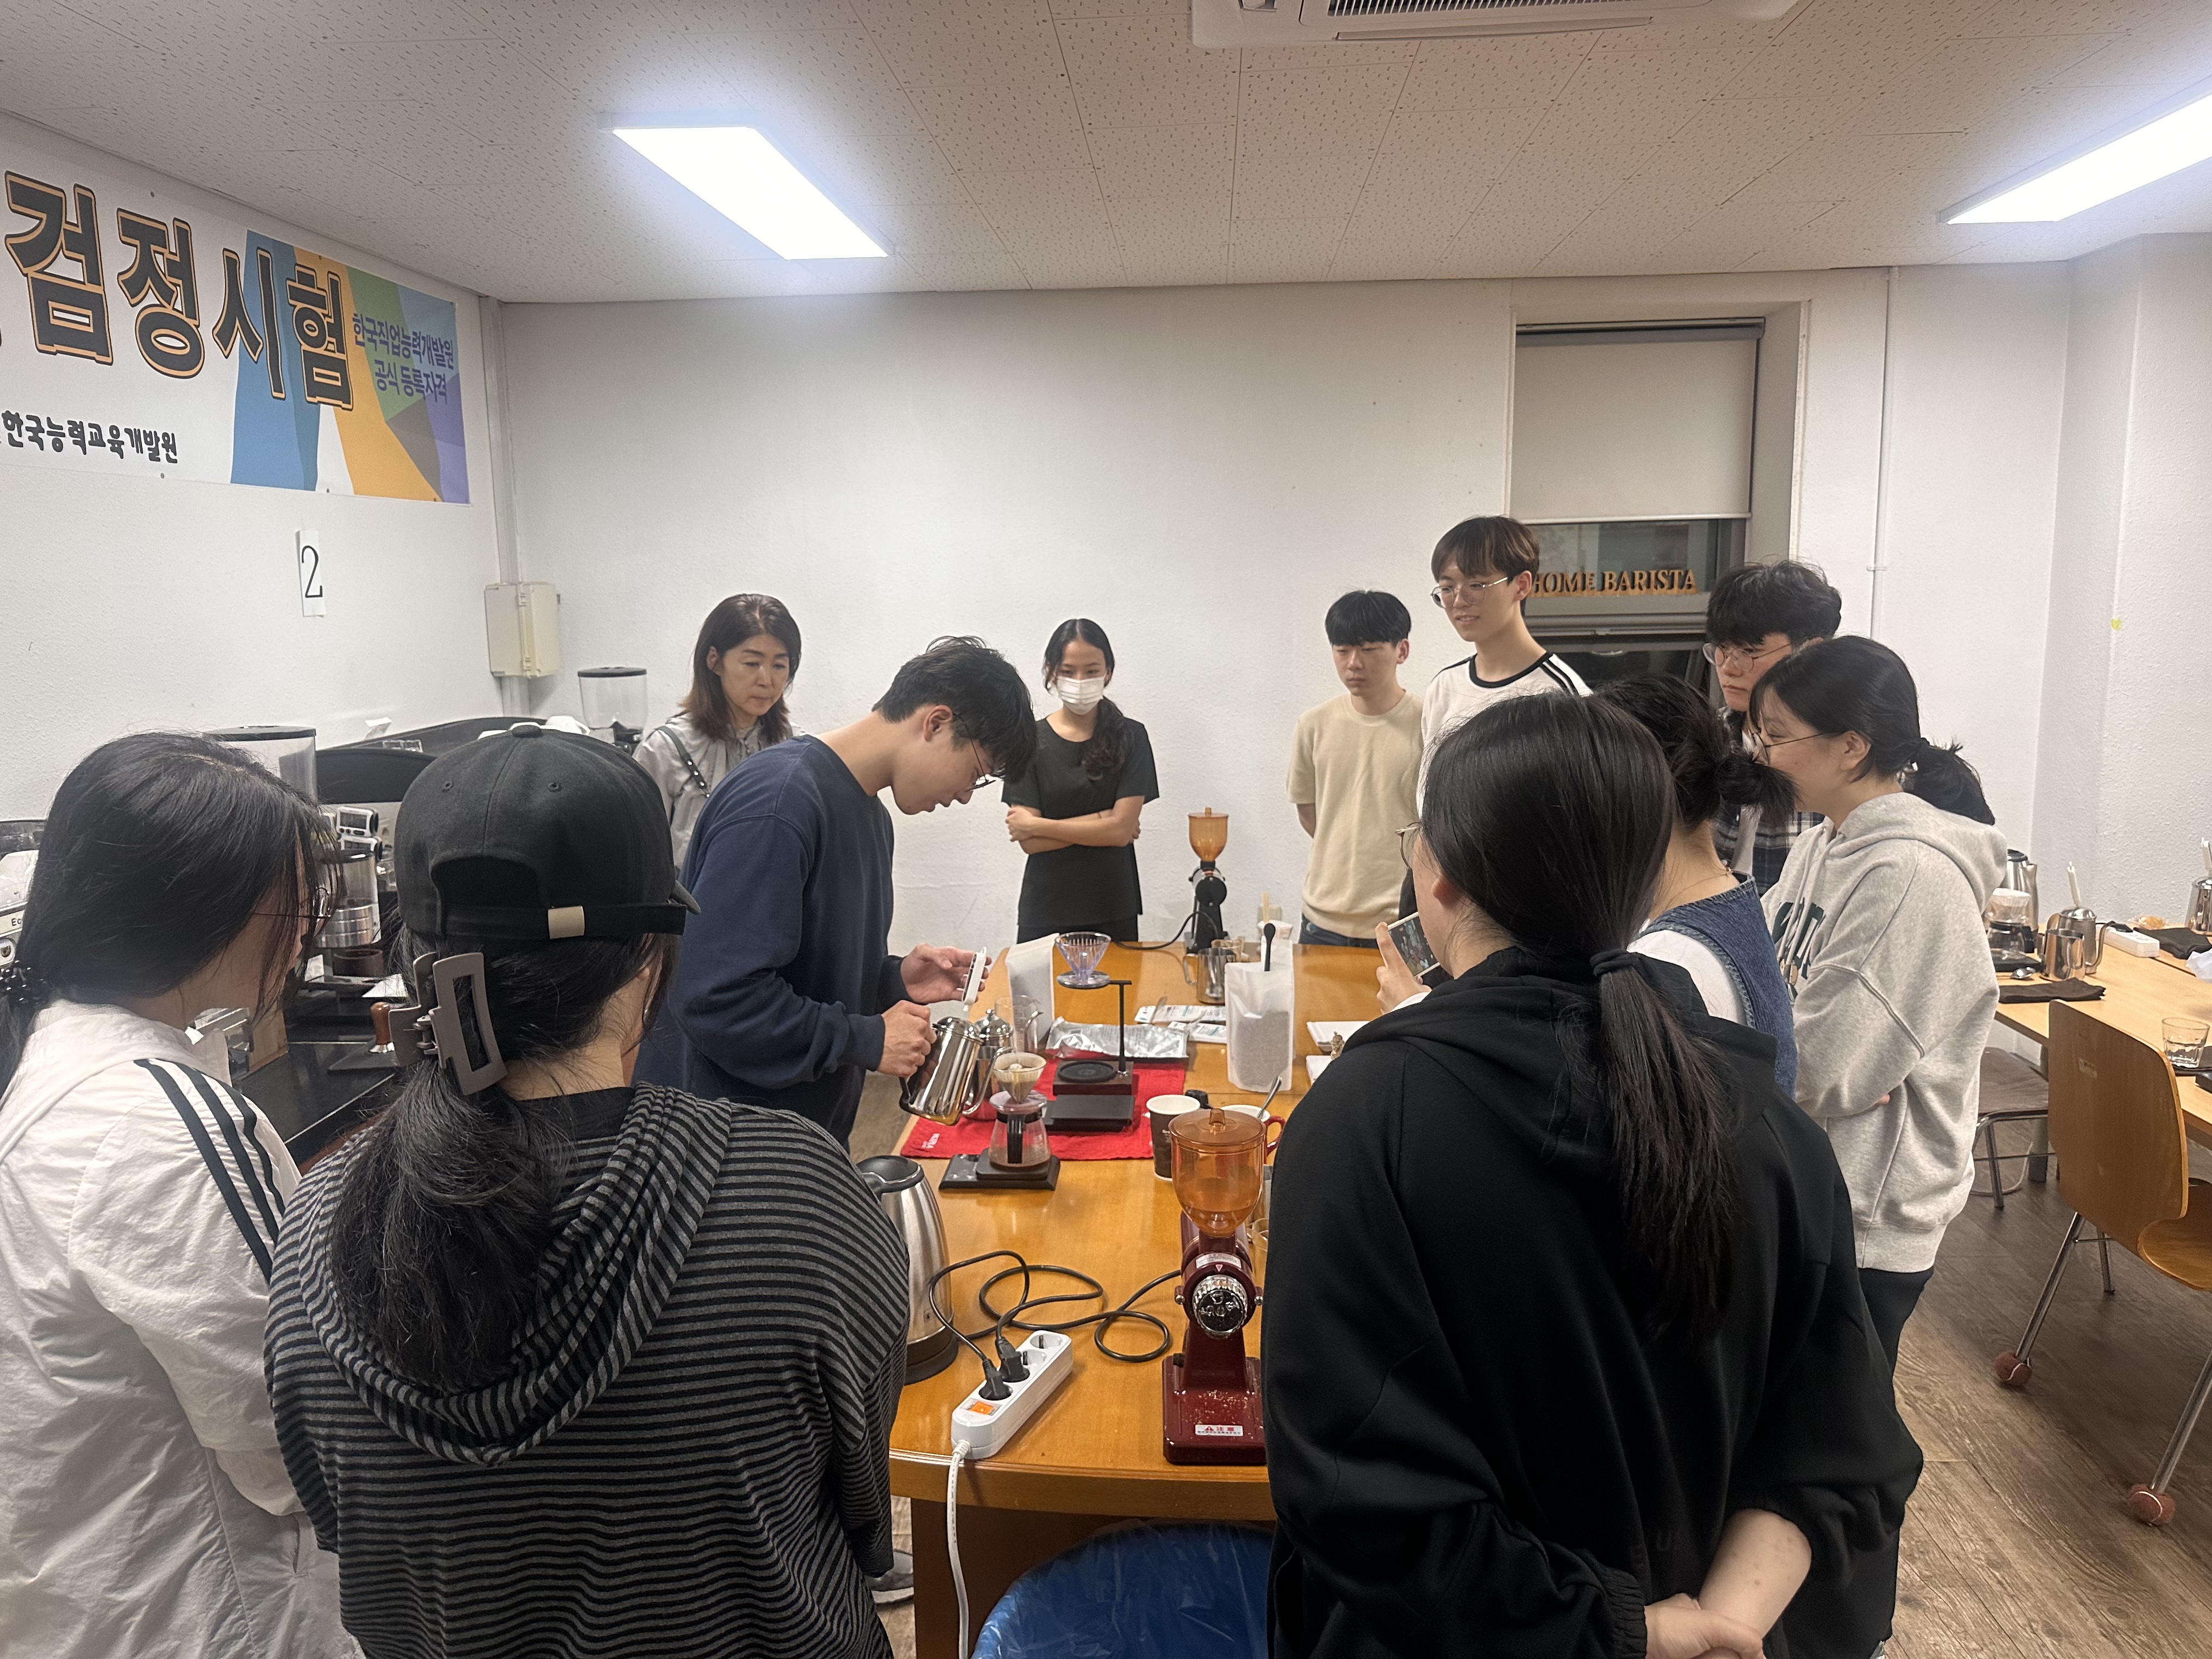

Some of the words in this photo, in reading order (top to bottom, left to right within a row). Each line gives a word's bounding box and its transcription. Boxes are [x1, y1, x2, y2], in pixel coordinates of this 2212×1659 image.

[352, 313, 454, 370] 한국직업능력개발원
[375, 359, 400, 396] 공식
[2, 410, 178, 464] 한국능력교육개발원
[302, 545, 323, 598] 2
[1602, 569, 1696, 592] BARISTA
